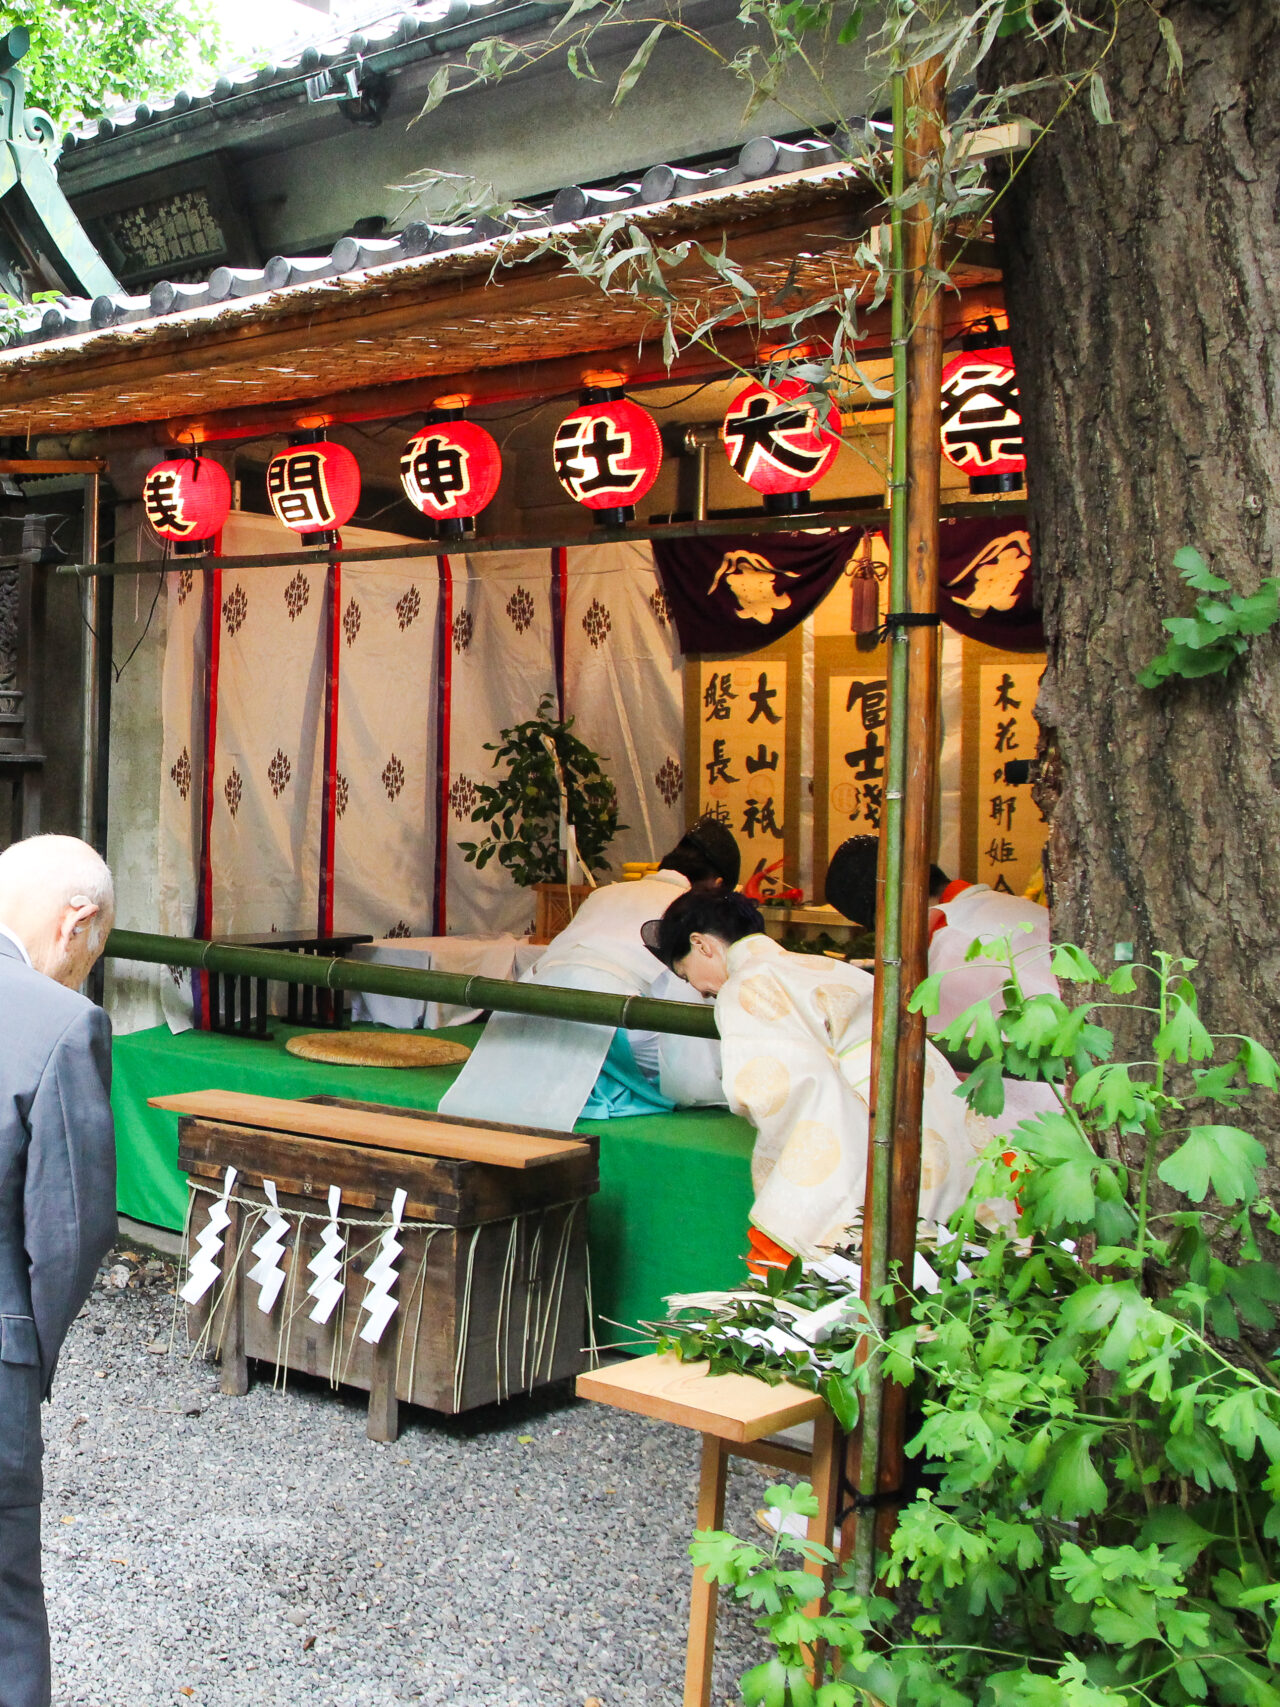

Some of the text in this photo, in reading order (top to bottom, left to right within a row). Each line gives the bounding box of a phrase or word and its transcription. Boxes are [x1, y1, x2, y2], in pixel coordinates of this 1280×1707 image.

[267, 451, 336, 531] 間
[400, 435, 470, 510] 神
[554, 416, 645, 501] 社
[725, 393, 832, 482] 大
[941, 365, 1024, 466] 祭
[984, 673, 1022, 896] 木花耶姫
